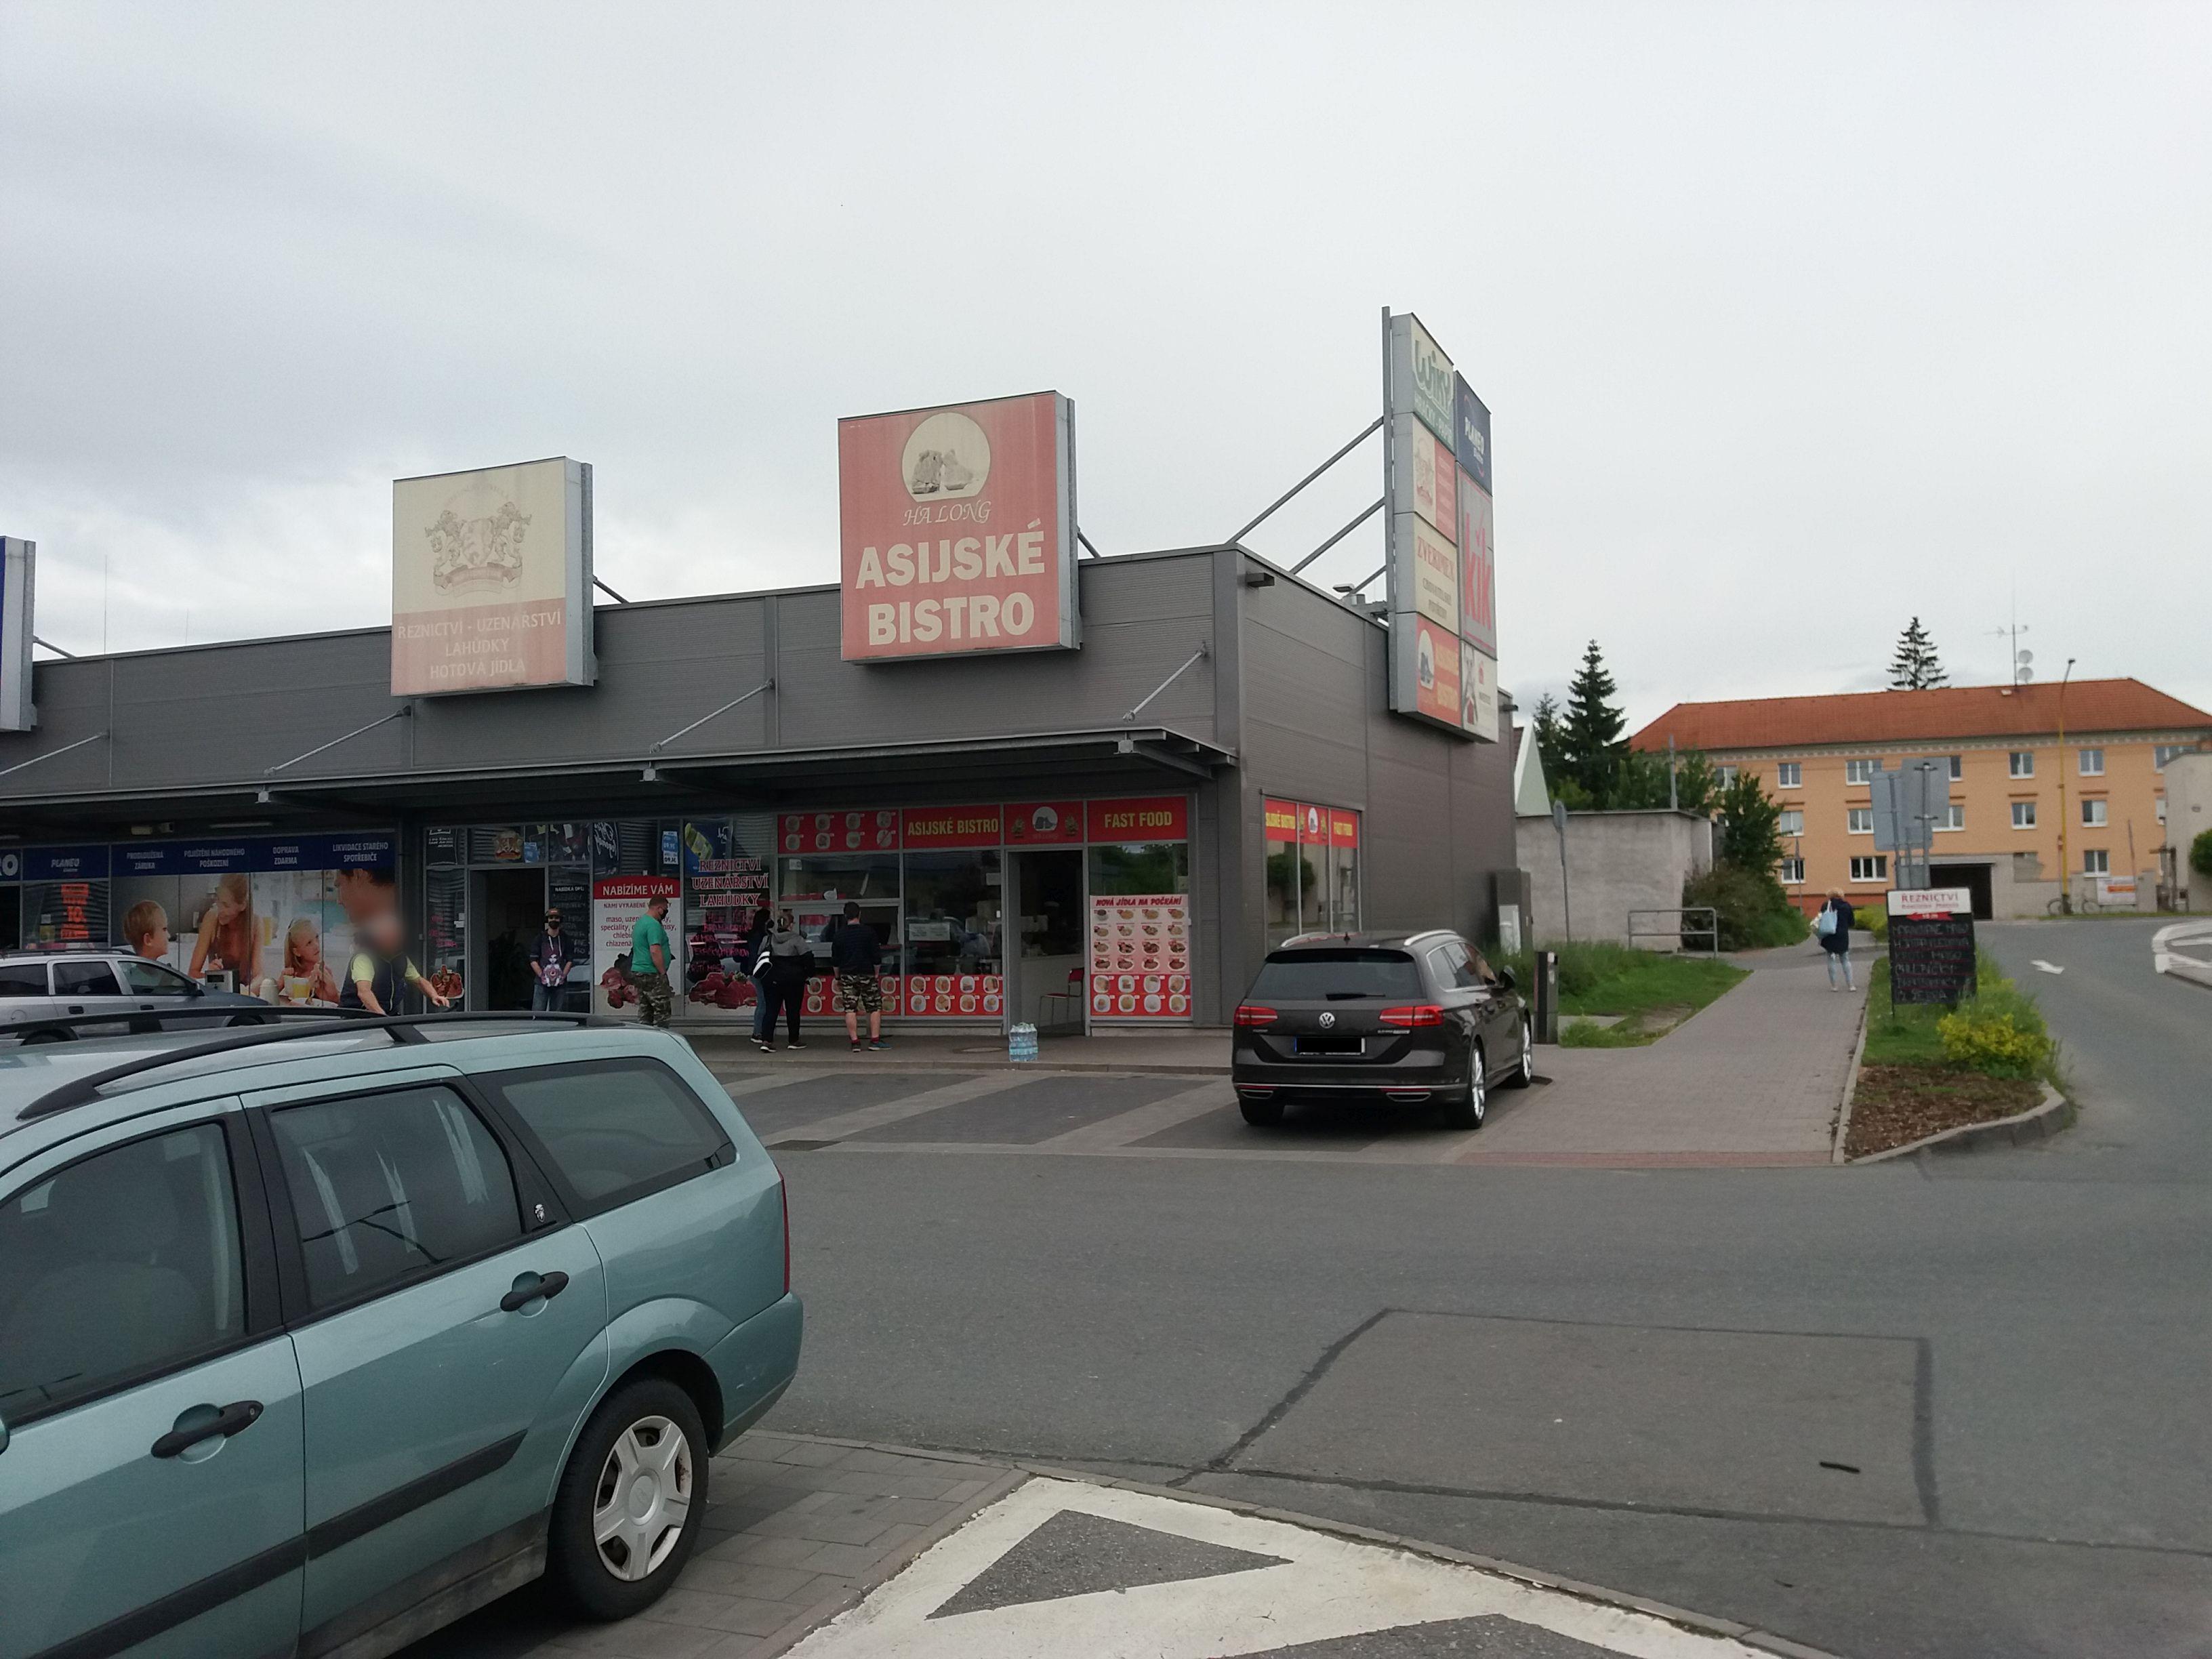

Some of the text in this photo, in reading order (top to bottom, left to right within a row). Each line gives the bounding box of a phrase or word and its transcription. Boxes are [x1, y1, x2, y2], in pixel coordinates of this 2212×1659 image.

[903, 499, 991, 526] HA LONG
[855, 518, 1045, 590] ASIJSKÉ
[398, 619, 463, 638] ŘEZNICTVÍ
[476, 609, 561, 633] UZENÁŘSTVÍ
[869, 592, 1034, 646] BISTRO
[446, 636, 510, 657] LAHŮDKY
[430, 655, 526, 678] HOTOVÁ JÍDLA
[907, 817, 998, 836] ASIJSKÉ BISTRO
[1104, 811, 1172, 827] FAST FOOD
[272, 846, 299, 854] DOPRAVA
[333, 842, 388, 852] LIKVIDACE STARÉHO
[51, 858, 80, 868] PLANEO
[274, 857, 298, 865] ZDARMA
[344, 853, 377, 863] SPOTŘEBIČE
[602, 882, 674, 896] NABÍZÍME VÁM
[691, 873, 769, 890] UZENÁŘSTVÍ
[699, 890, 761, 907] LAHŮDKY
[1096, 897, 1114, 906] NOVÁ
[1116, 897, 1136, 906] JÍDLA
[1150, 896, 1182, 905] POČKÁNÍ
[601, 923, 630, 932] speciality,
